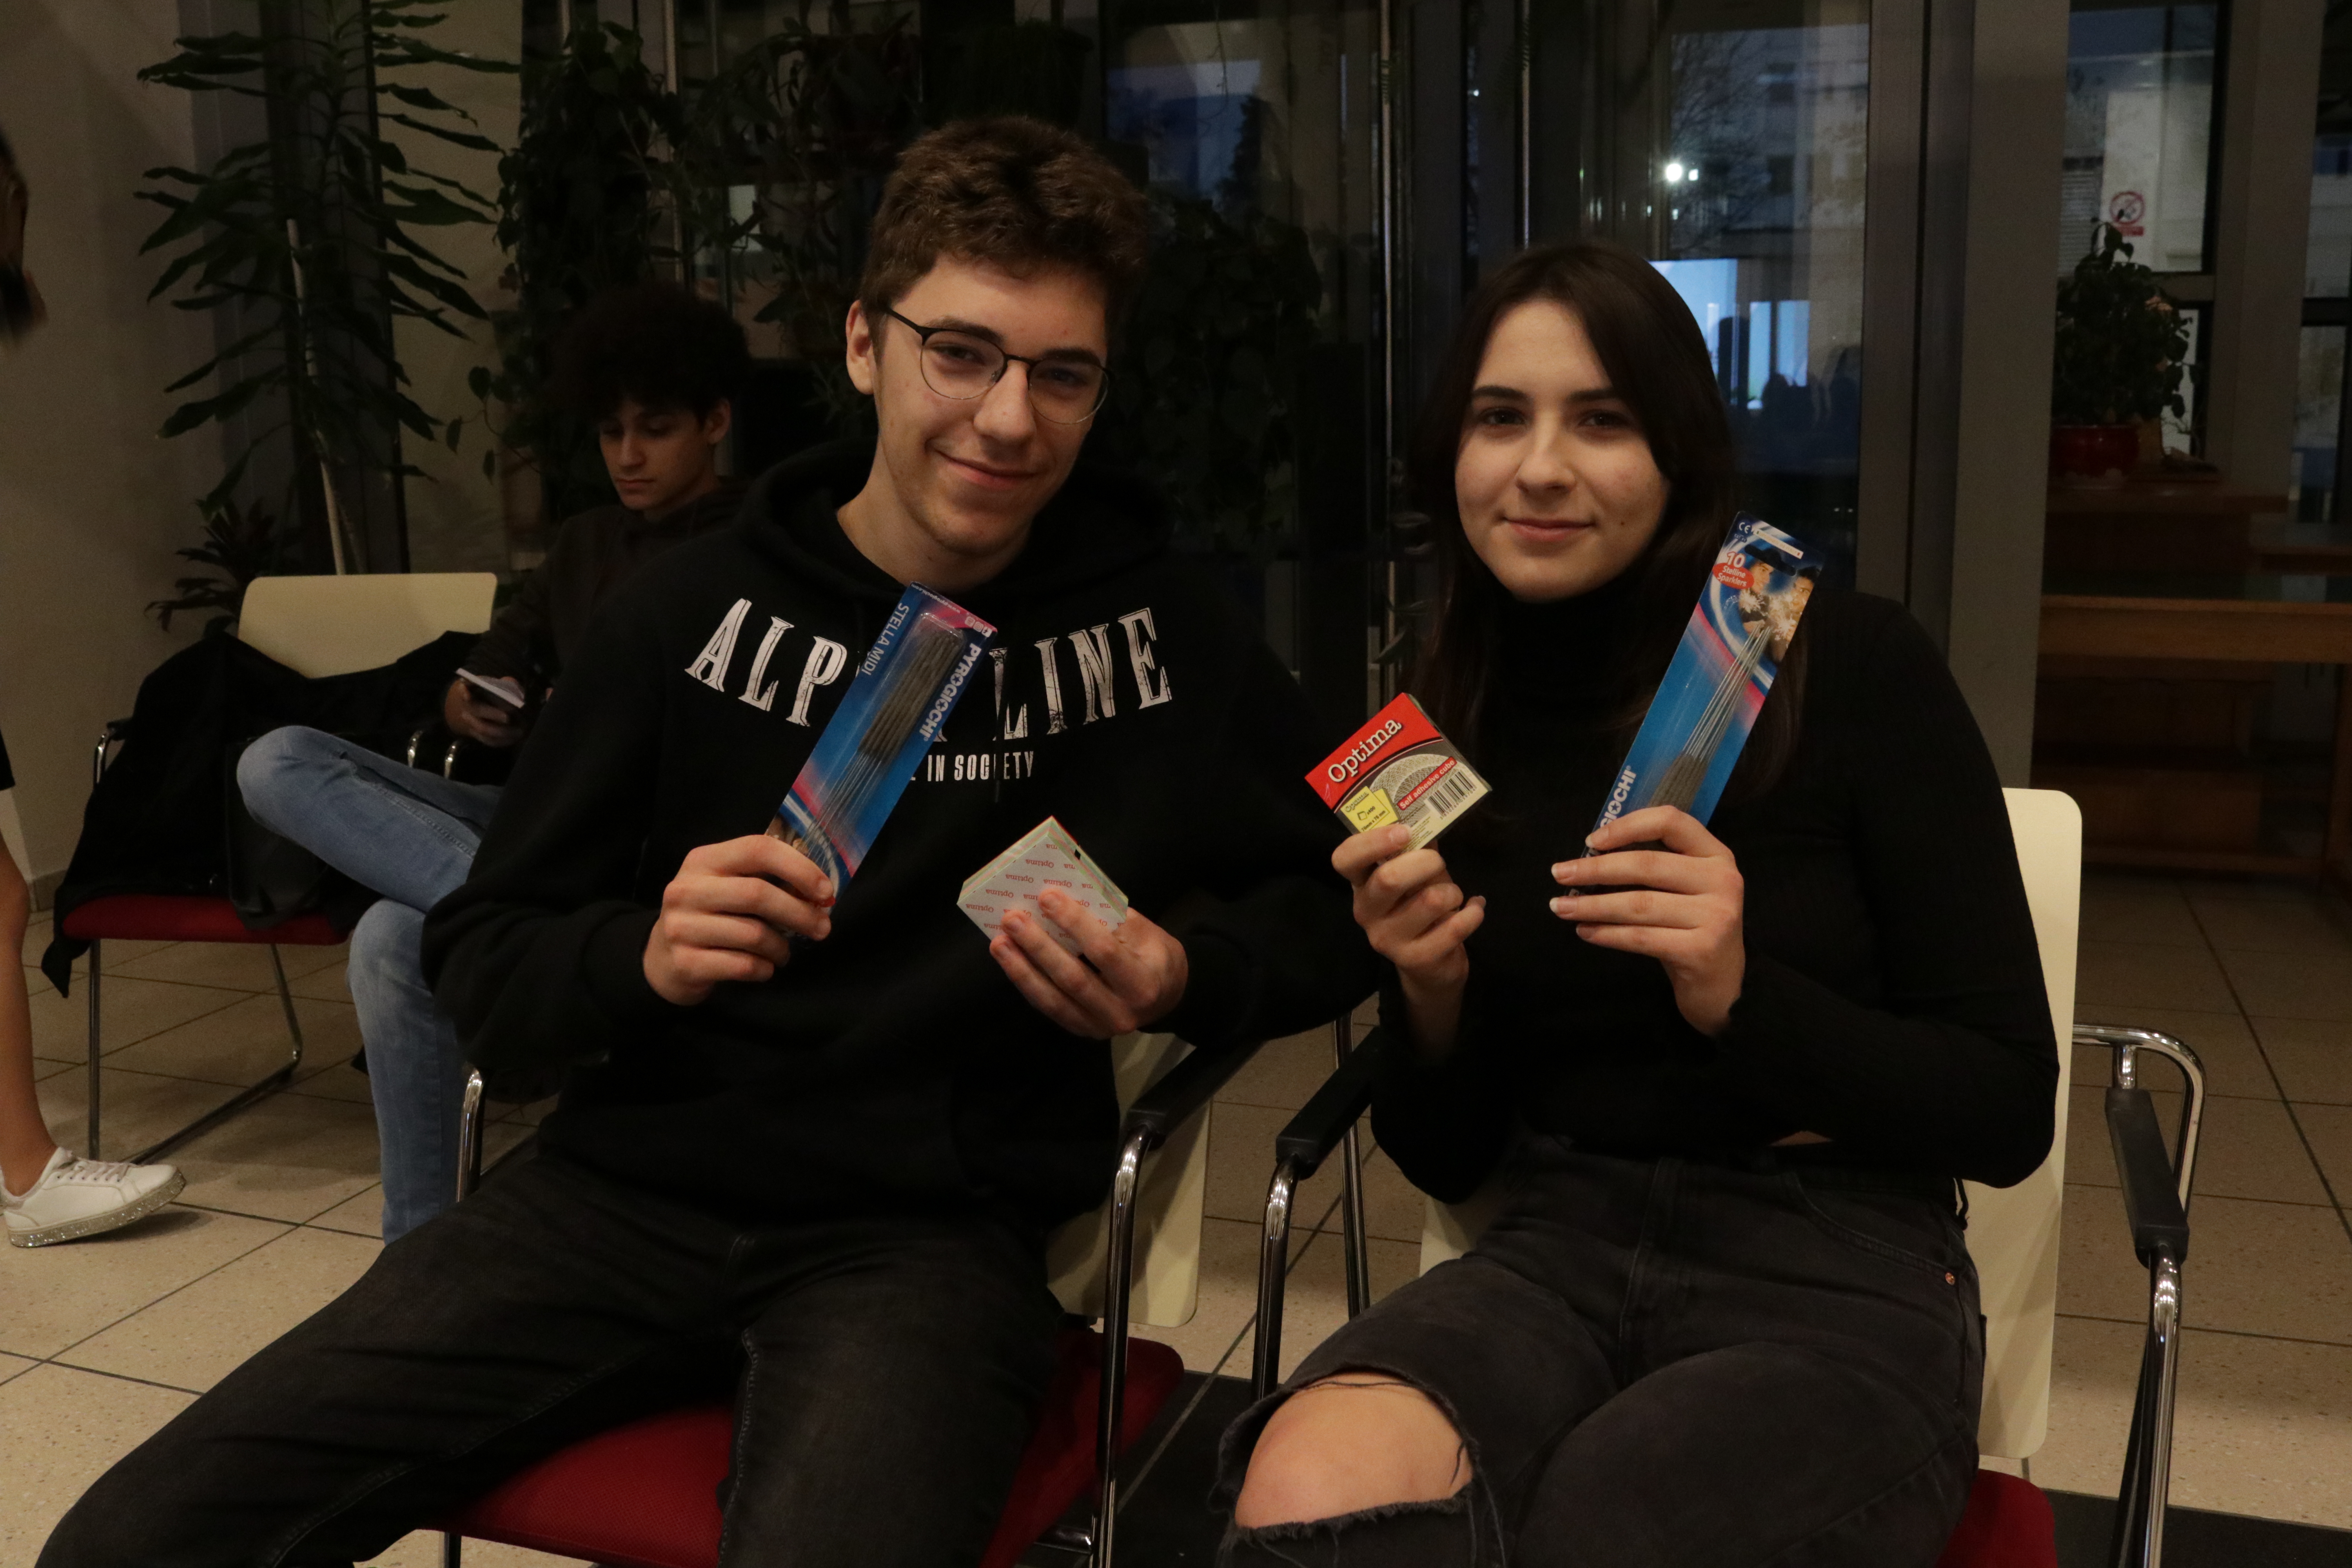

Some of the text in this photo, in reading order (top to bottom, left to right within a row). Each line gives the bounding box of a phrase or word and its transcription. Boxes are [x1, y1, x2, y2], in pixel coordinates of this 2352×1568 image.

[1727, 552, 1746, 568] 10
[1722, 566, 1746, 578] Stelline
[1717, 573, 1747, 587] Sparklers
[861, 603, 909, 675] STELLA MIDI
[919, 642, 982, 739] PYROGIOCHI
[1328, 719, 1402, 782] Optima
[927, 755, 945, 782] IN
[1400, 760, 1455, 809] Self adhesive cube
[1367, 806, 1376, 815] x400
[1025, 859, 1054, 868] Optima
[1005, 874, 1034, 883] Optima
[1044, 879, 1072, 887] Optima
[985, 889, 1014, 898] Optima
[966, 904, 994, 912] Optima
